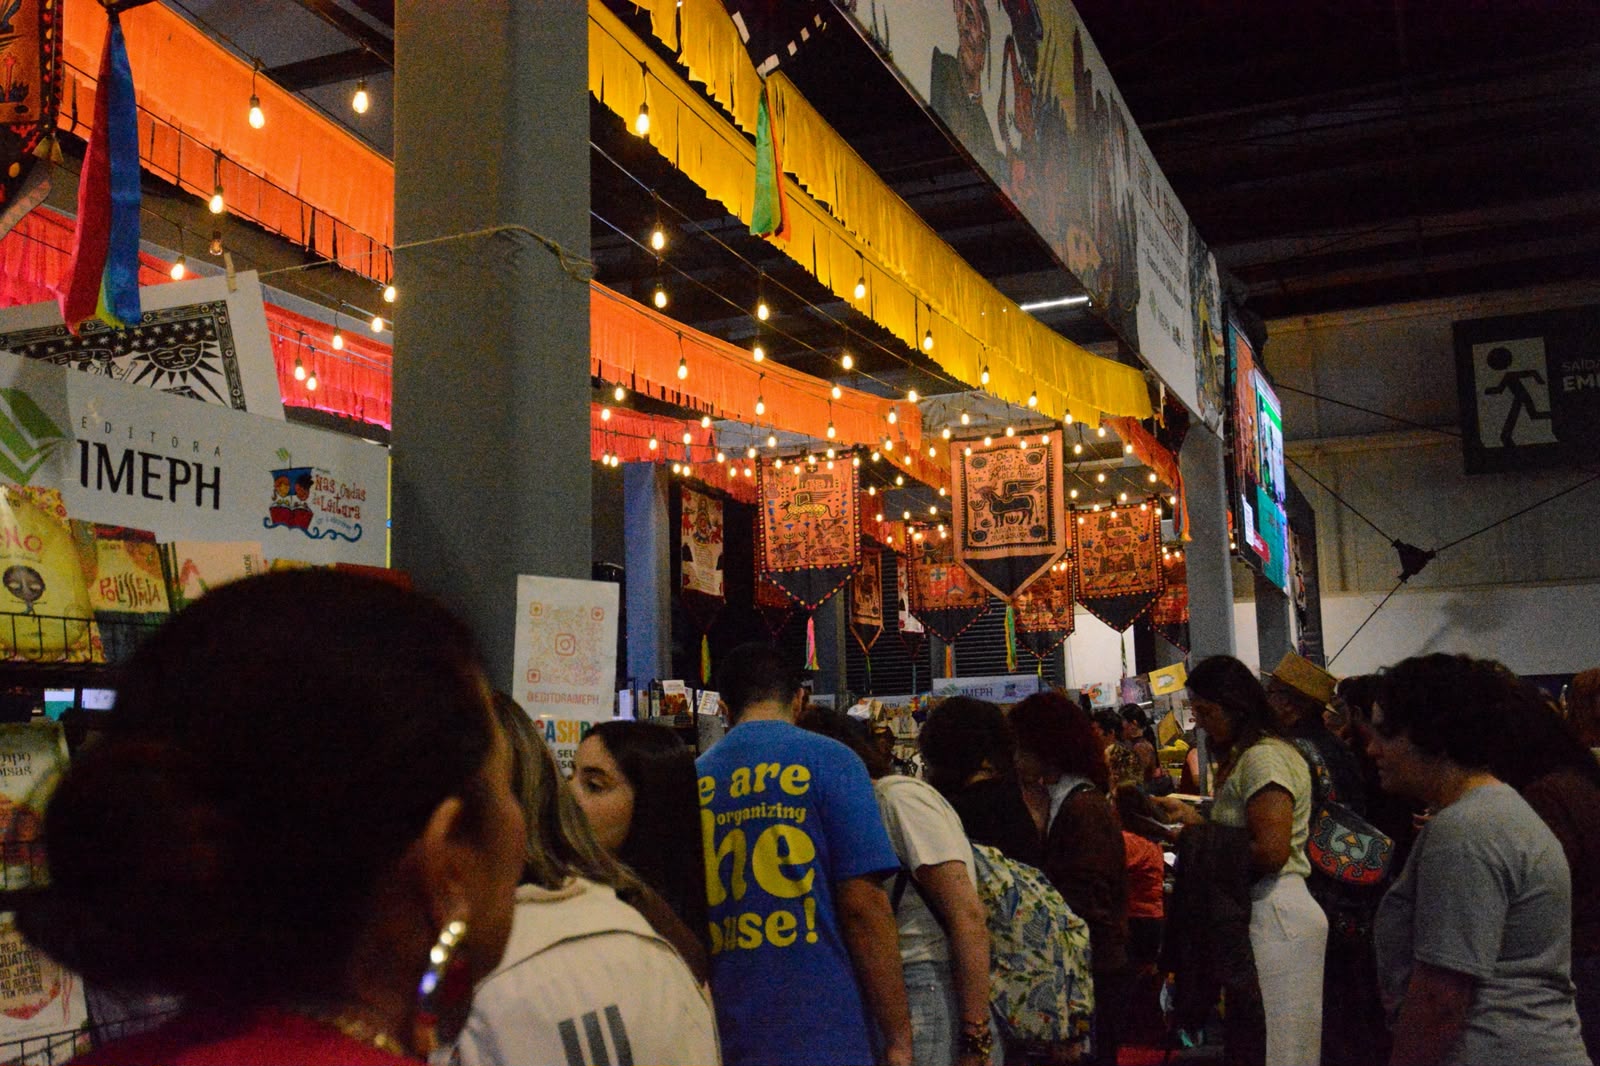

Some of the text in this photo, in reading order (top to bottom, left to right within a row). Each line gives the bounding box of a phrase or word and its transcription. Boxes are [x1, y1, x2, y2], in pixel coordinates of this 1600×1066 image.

[1563, 373, 1600, 392] EM
[81, 416, 221, 457] EDITORA
[77, 439, 221, 510] IMEPH
[314, 474, 336, 494] Nas
[320, 494, 361, 520] Leitura
[527, 691, 600, 705] @EDITORAIMEPH
[729, 762, 812, 798] are
[716, 802, 807, 826] organizing
[699, 808, 816, 907] he
